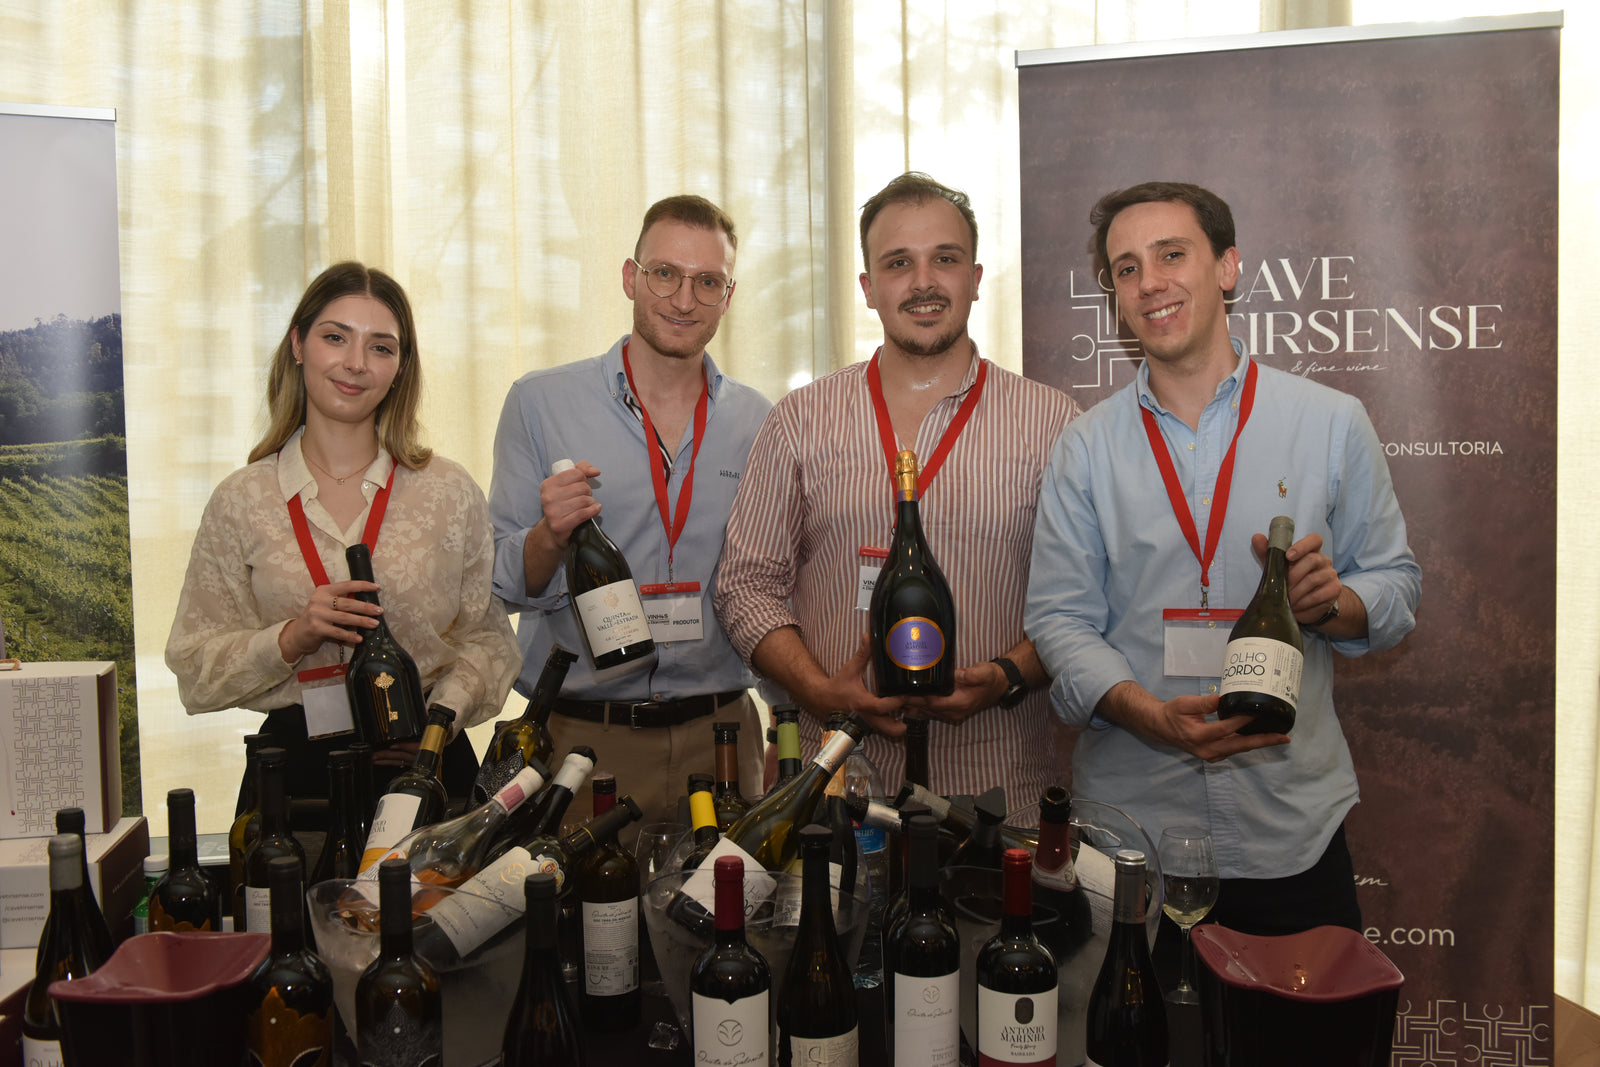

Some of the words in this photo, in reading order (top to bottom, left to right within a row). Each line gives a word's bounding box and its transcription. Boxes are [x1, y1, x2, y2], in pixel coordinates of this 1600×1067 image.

[1302, 361, 1342, 378] fine
[1346, 362, 1388, 372] wine
[1380, 441, 1504, 456] ONSULTORIA
[1230, 652, 1267, 664] OLHO
[1222, 664, 1265, 680] GORDO
[1000, 1032, 1046, 1043] MARINHA
